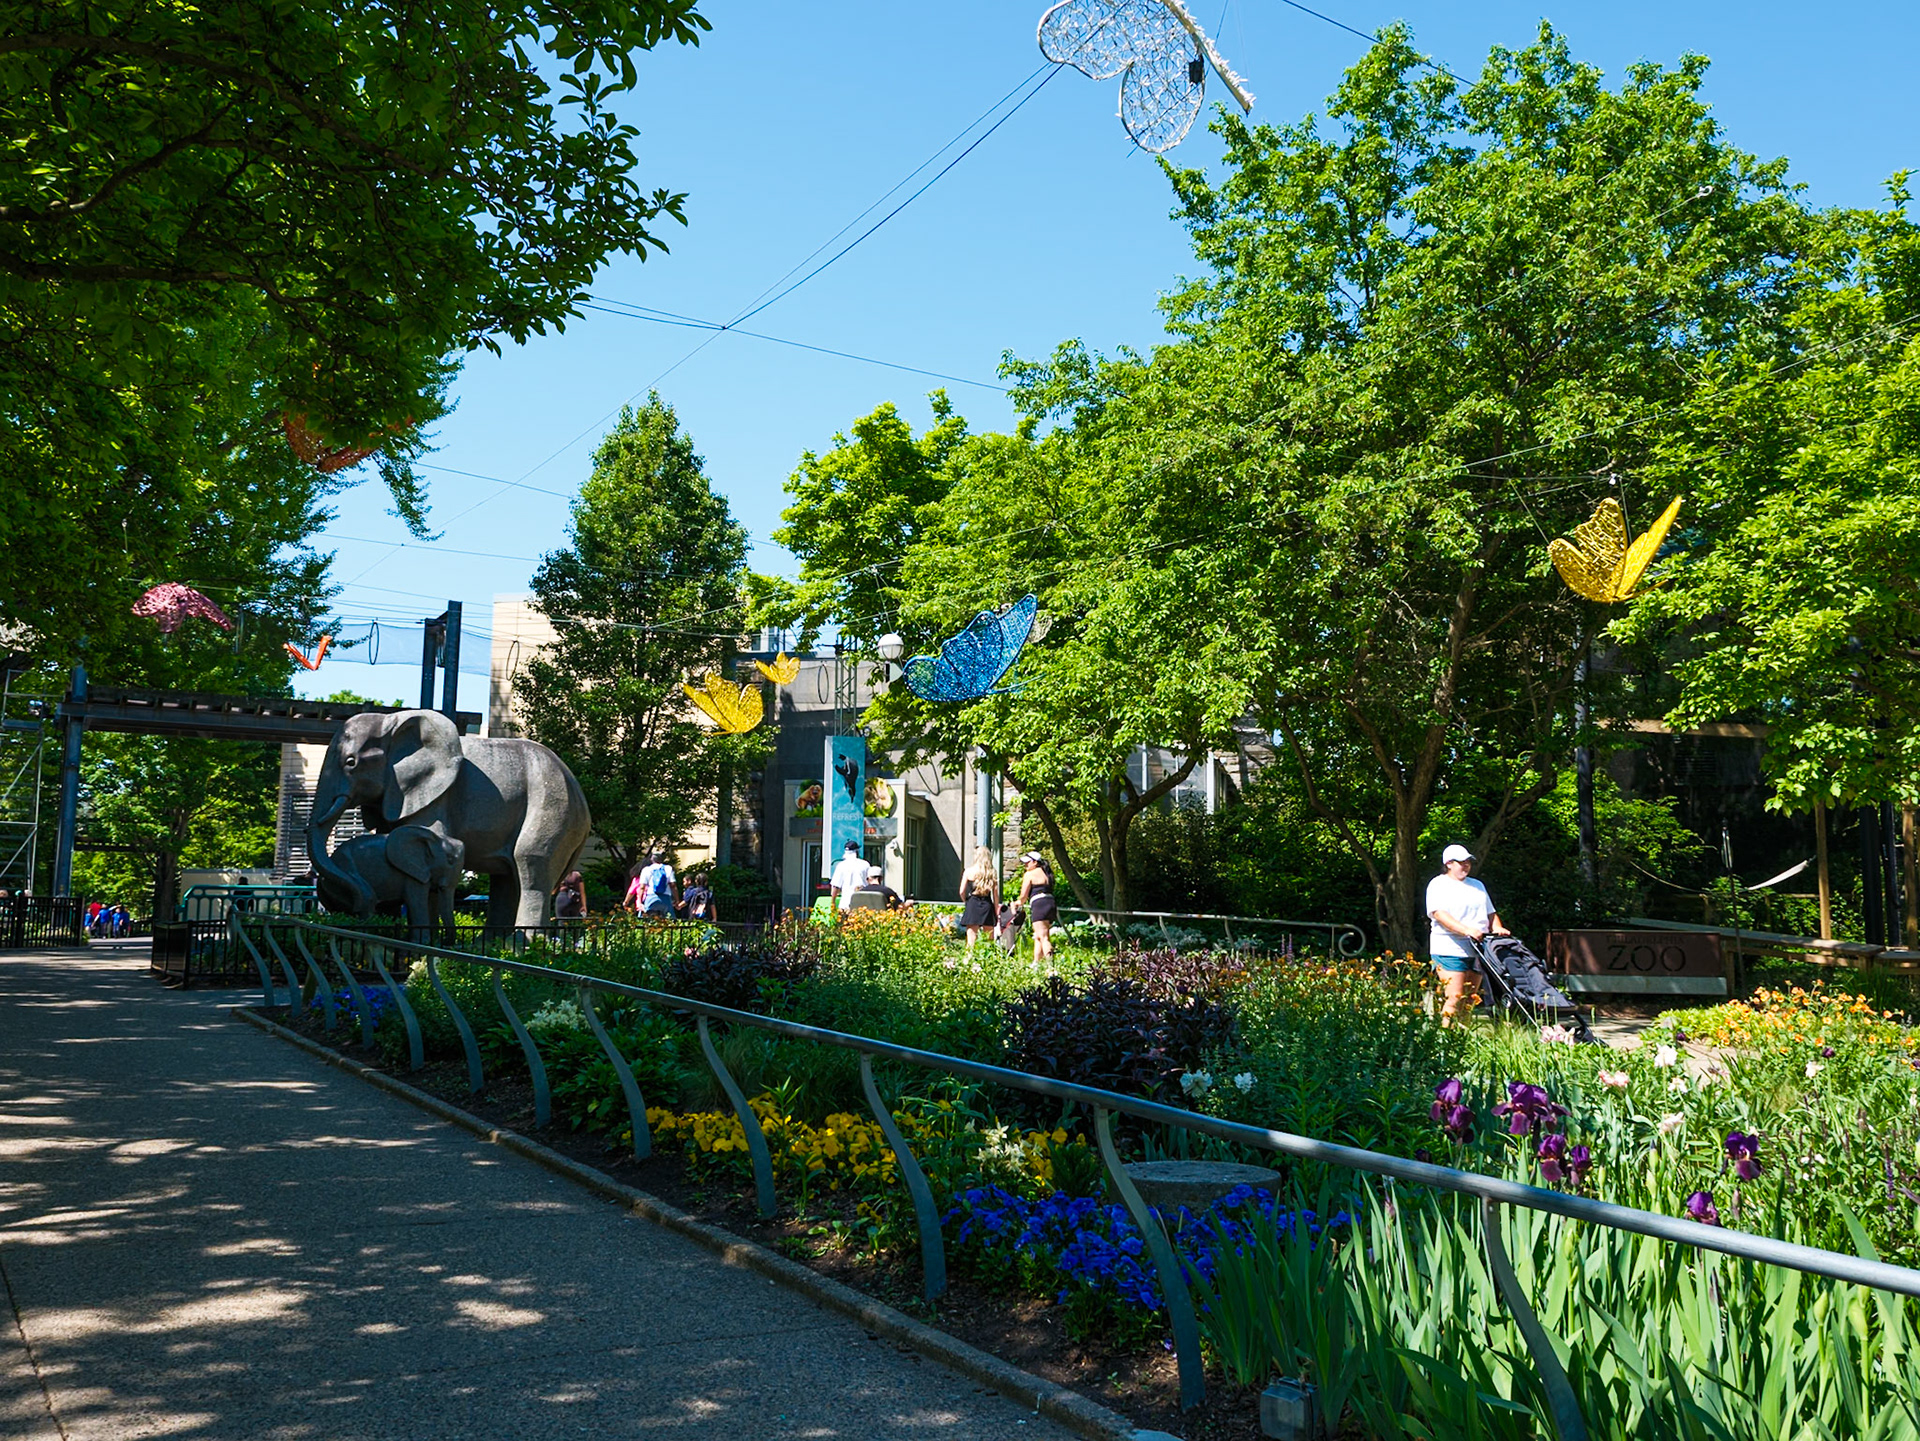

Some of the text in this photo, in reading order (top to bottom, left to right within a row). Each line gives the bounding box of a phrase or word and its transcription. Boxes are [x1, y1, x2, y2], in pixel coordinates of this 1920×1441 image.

[833, 812, 863, 821] REFRESH
[1606, 935, 1685, 945] PHILADELPHIA
[1607, 945, 1686, 972] ZOO
